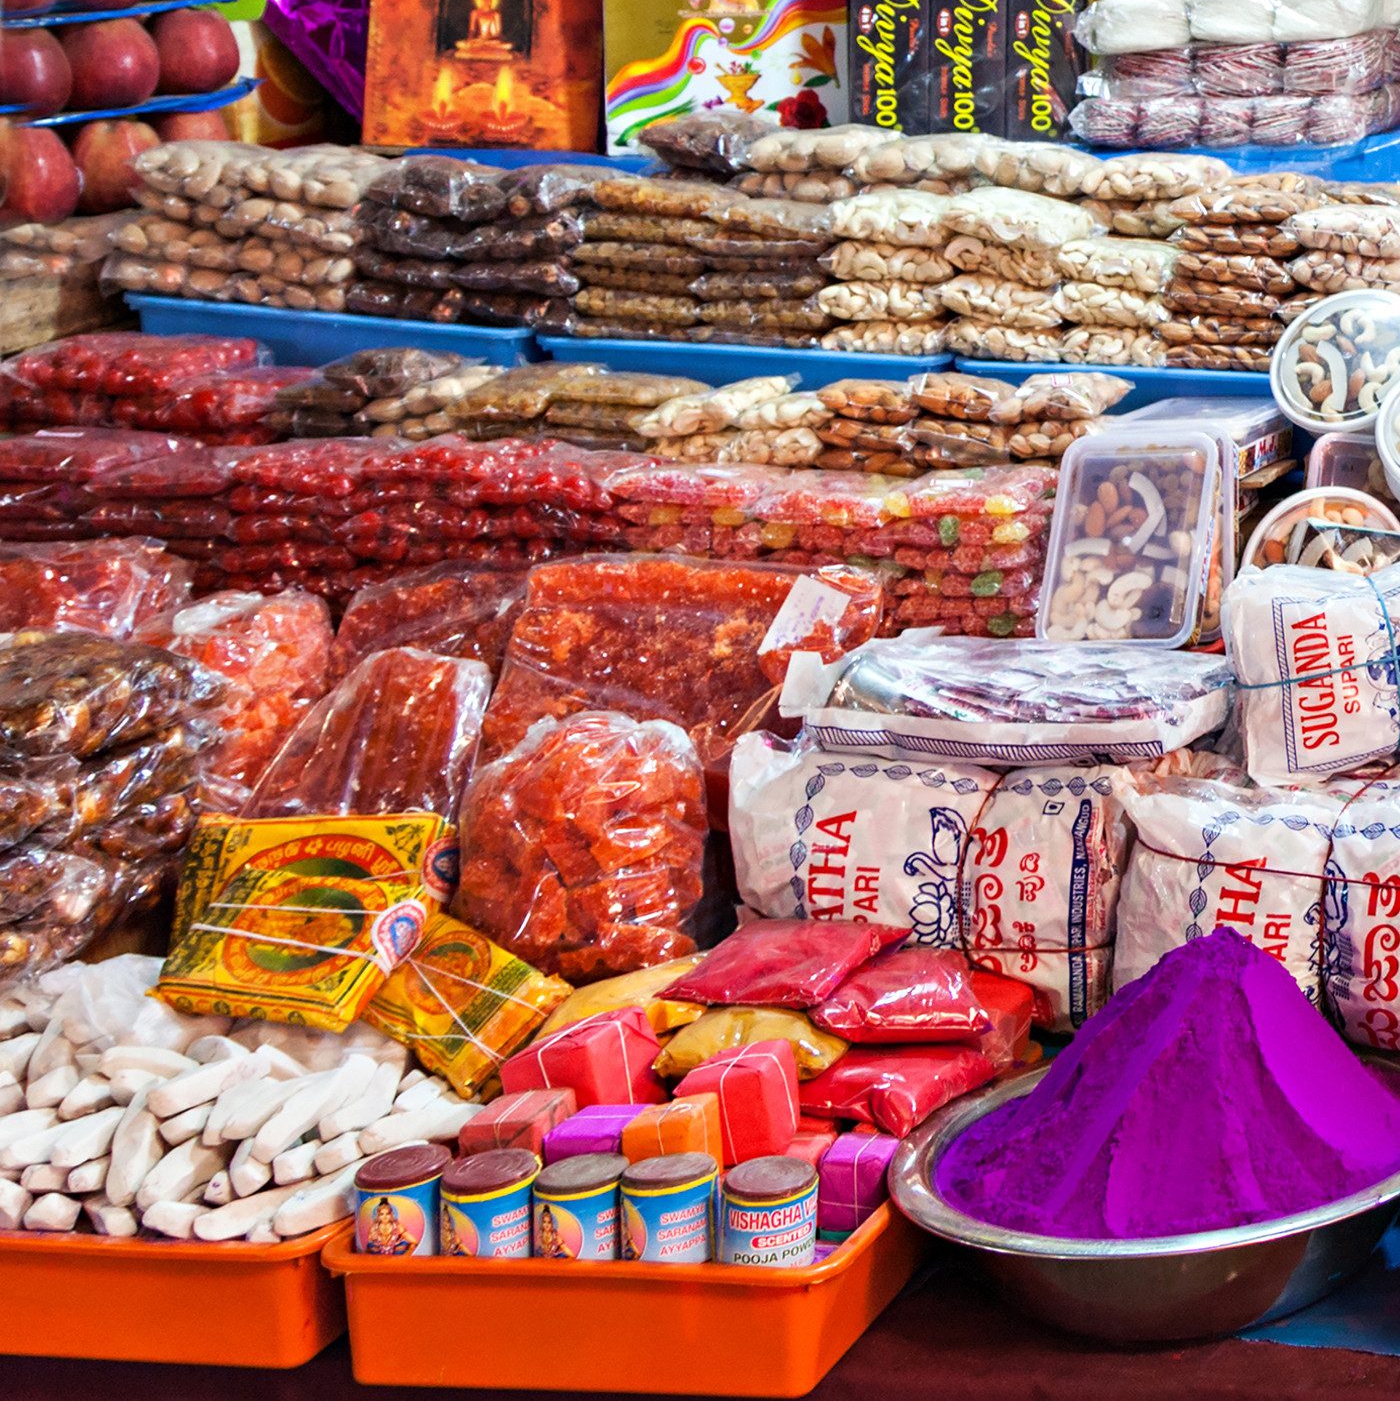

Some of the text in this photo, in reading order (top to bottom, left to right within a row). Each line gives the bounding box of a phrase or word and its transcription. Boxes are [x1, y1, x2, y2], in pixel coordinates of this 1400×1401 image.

[1291, 612, 1340, 750] SUGANDA
[1337, 634, 1361, 714] SUPARI
[1071, 864, 1086, 924] INDUSTRIES,
[1071, 955, 1086, 1013] RAMANANDA
[729, 1204, 801, 1231] VISHAGHA
[757, 1226, 810, 1248] SCENTED
[734, 1252, 778, 1264] POOJA
